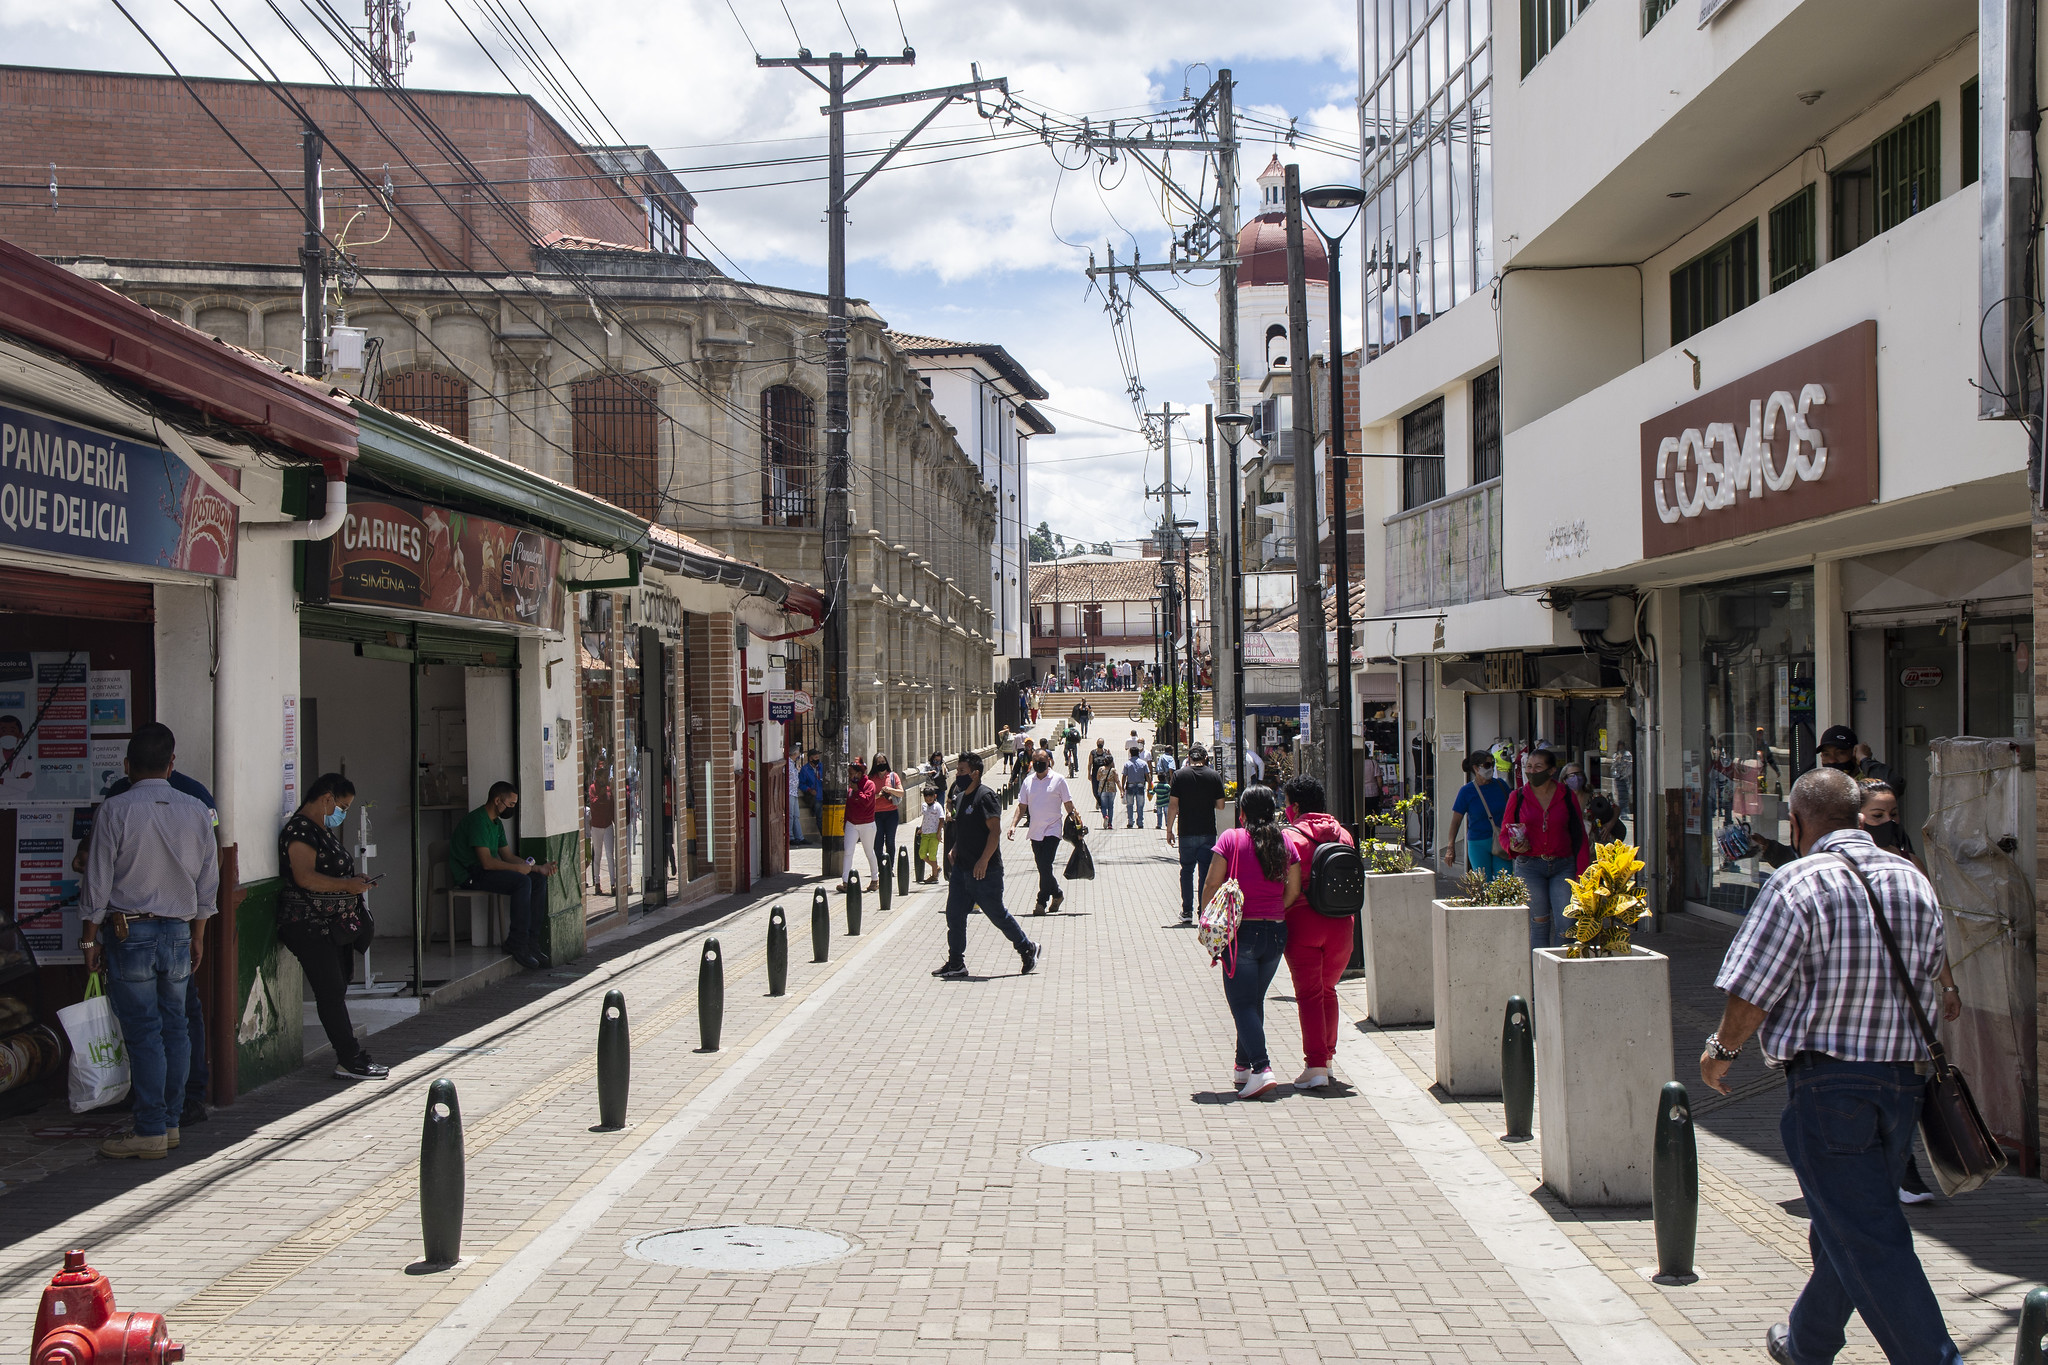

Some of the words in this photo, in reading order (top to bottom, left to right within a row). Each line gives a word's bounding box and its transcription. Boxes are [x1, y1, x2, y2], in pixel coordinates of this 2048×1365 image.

[2, 423, 129, 494] PANADERÍA
[1653, 382, 1828, 524] COSMOS
[1, 482, 47, 532] QUE
[53, 492, 129, 545] DELICIA
[343, 513, 421, 562] CARNES
[360, 573, 406, 592] SIMONA
